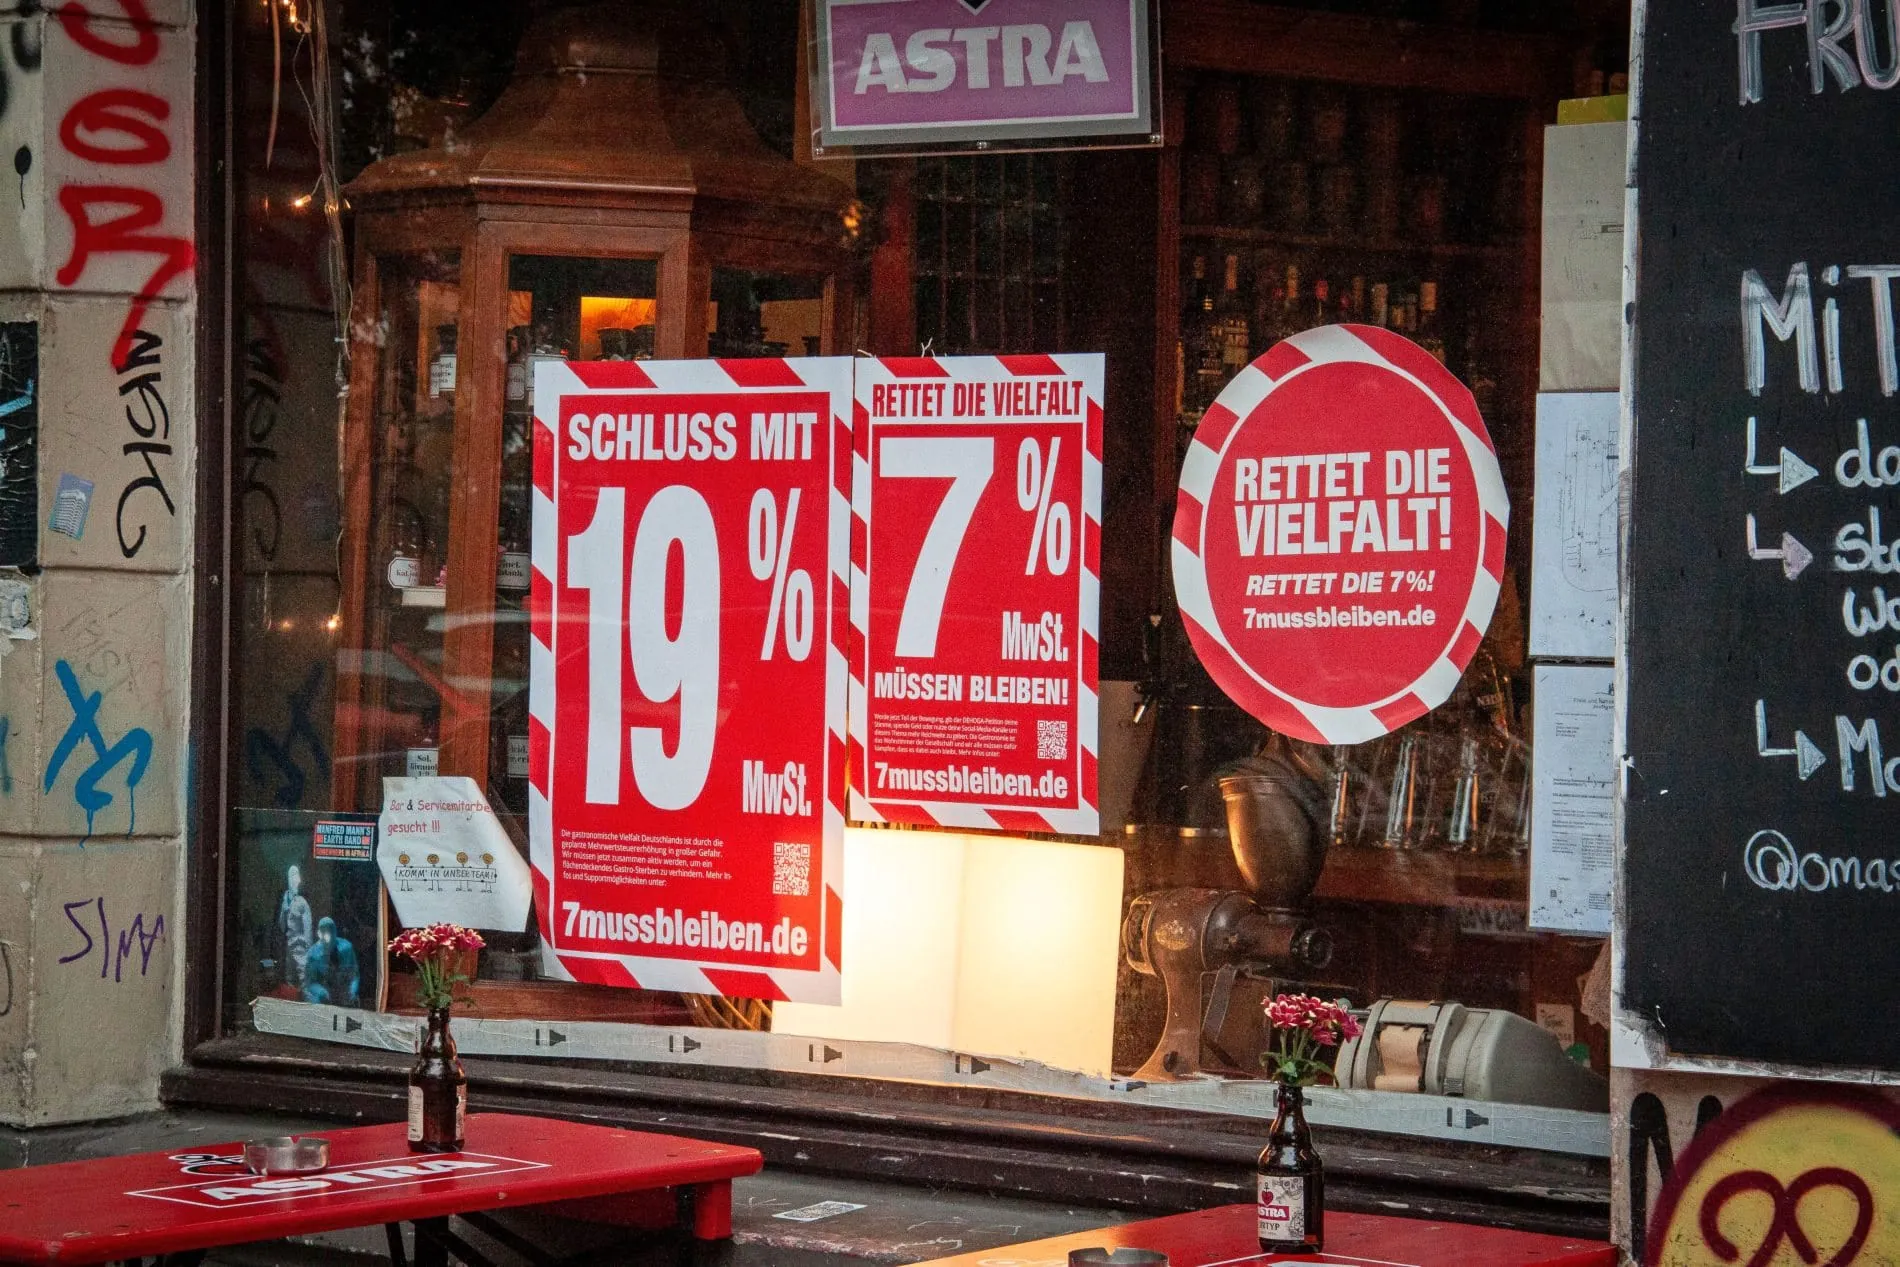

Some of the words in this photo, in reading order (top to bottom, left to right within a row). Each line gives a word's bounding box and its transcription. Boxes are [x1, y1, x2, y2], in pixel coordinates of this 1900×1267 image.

[854, 20, 1109, 94] ASTRA
[873, 383, 945, 417] RETTET
[953, 383, 986, 417] DIE
[993, 381, 1083, 416] VIELFALT
[568, 412, 737, 461] SCHLUSS
[751, 412, 817, 460] MIT
[1234, 452, 1370, 501] RETTET
[1386, 448, 1450, 495] DIE
[1234, 497, 1451, 557] VIELFALT!
[880, 437, 994, 657] 7
[1246, 572, 1338, 596] RETTET
[1341, 571, 1383, 595] DIE
[1389, 570, 1435, 592] 7%!
[1243, 605, 1436, 629] 7mussbleiben.de
[567, 485, 720, 811] 19
[1002, 611, 1068, 662] MwSt.
[875, 666, 962, 702] MÜSSEN
[970, 676, 1068, 706] BLEIBEN!
[742, 760, 812, 817] MwSt.
[874, 762, 1068, 799] 7mussbleiben.de
[407, 800, 413, 811] &
[316, 825, 344, 834] MANFRED
[324, 835, 343, 844] EARTH
[344, 835, 362, 845] BAND
[388, 820, 427, 837] gesucht
[561, 829, 570, 837] Die
[572, 830, 618, 841] gastronomische
[619, 833, 640, 841] Vielfalt
[641, 834, 682, 844] Deutschlands
[692, 837, 711, 846] durch
[573, 851, 595, 859] müssen
[596, 853, 610, 862] jetzt
[611, 855, 645, 863] zusammen
[647, 856, 661, 864] aktiv
[663, 857, 688, 867] werden,
[702, 859, 712, 867] ein
[587, 842, 666, 855] Mehrwertsteuererhöhung
[675, 847, 696, 857] großer
[698, 848, 722, 857] Gefahr.
[430, 869, 440, 878] IN
[562, 861, 612, 871] flächendeckendes
[613, 864, 658, 875] Gastro-Sterben
[668, 868, 704, 878] verhindern.
[706, 870, 722, 879] Mehr
[572, 871, 582, 880] und
[584, 872, 647, 887] Supportmöglichkeiten
[562, 901, 808, 955] 7mussbleiben.de
[202, 1159, 499, 1201] ASTRA
